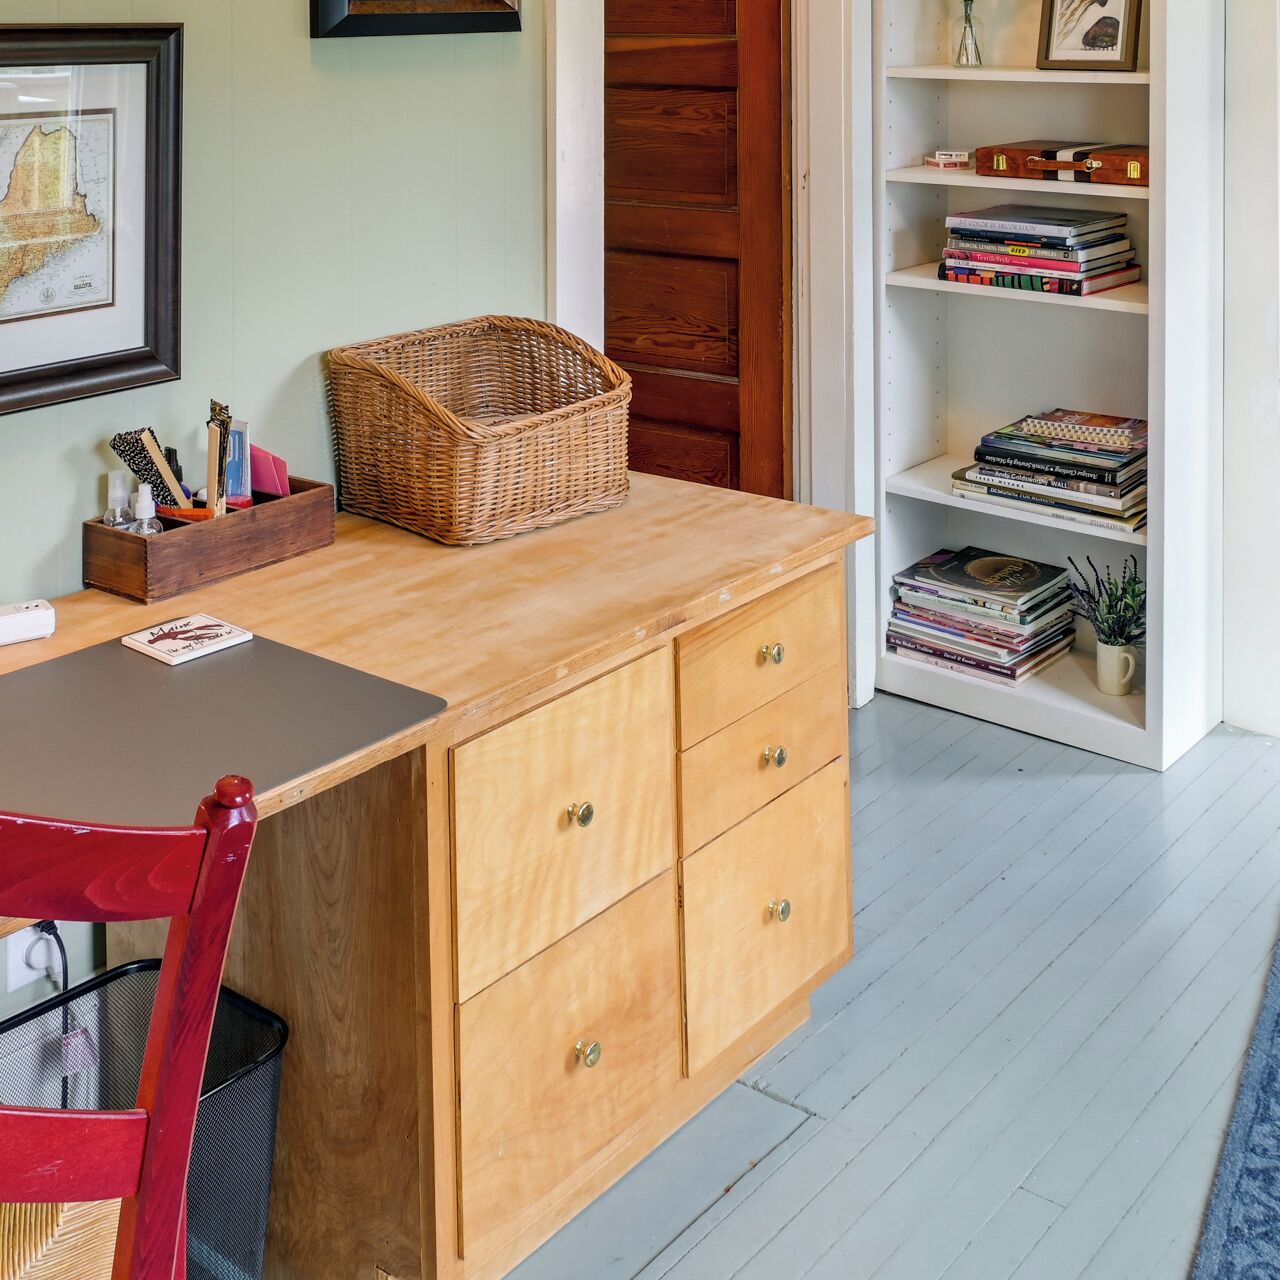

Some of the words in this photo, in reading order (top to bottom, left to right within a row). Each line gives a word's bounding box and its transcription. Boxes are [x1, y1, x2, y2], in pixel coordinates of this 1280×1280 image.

[1010, 246, 1027, 255] USED
[994, 471, 1011, 480] Andy
[1051, 480, 1068, 489] WALL
